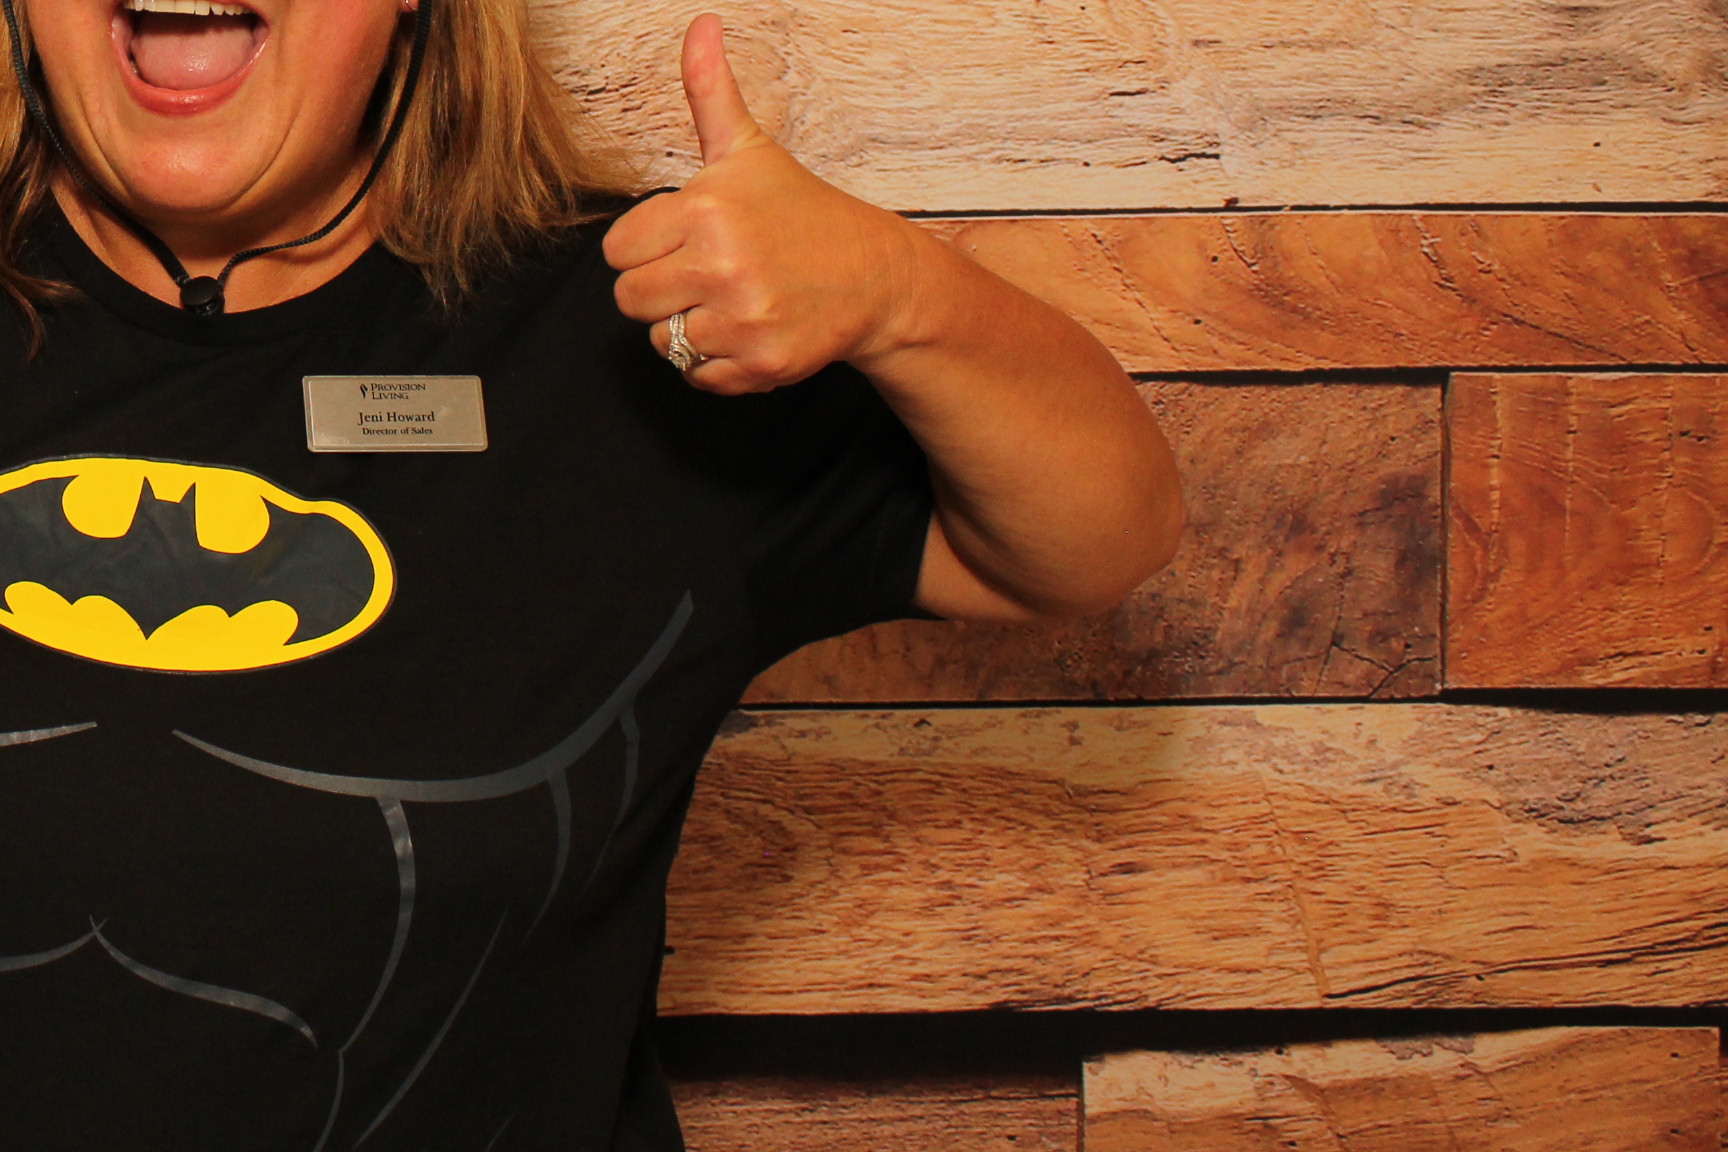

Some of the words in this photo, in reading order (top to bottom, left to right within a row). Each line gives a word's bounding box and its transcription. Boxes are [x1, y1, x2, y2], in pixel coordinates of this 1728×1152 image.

[370, 383, 426, 391] PROVISION
[371, 391, 409, 400] LIVING
[357, 411, 383, 425] Jeni
[387, 411, 436, 423] Howard
[362, 427, 397, 435] Director
[400, 427, 410, 435] of
[411, 426, 433, 435] Sales
